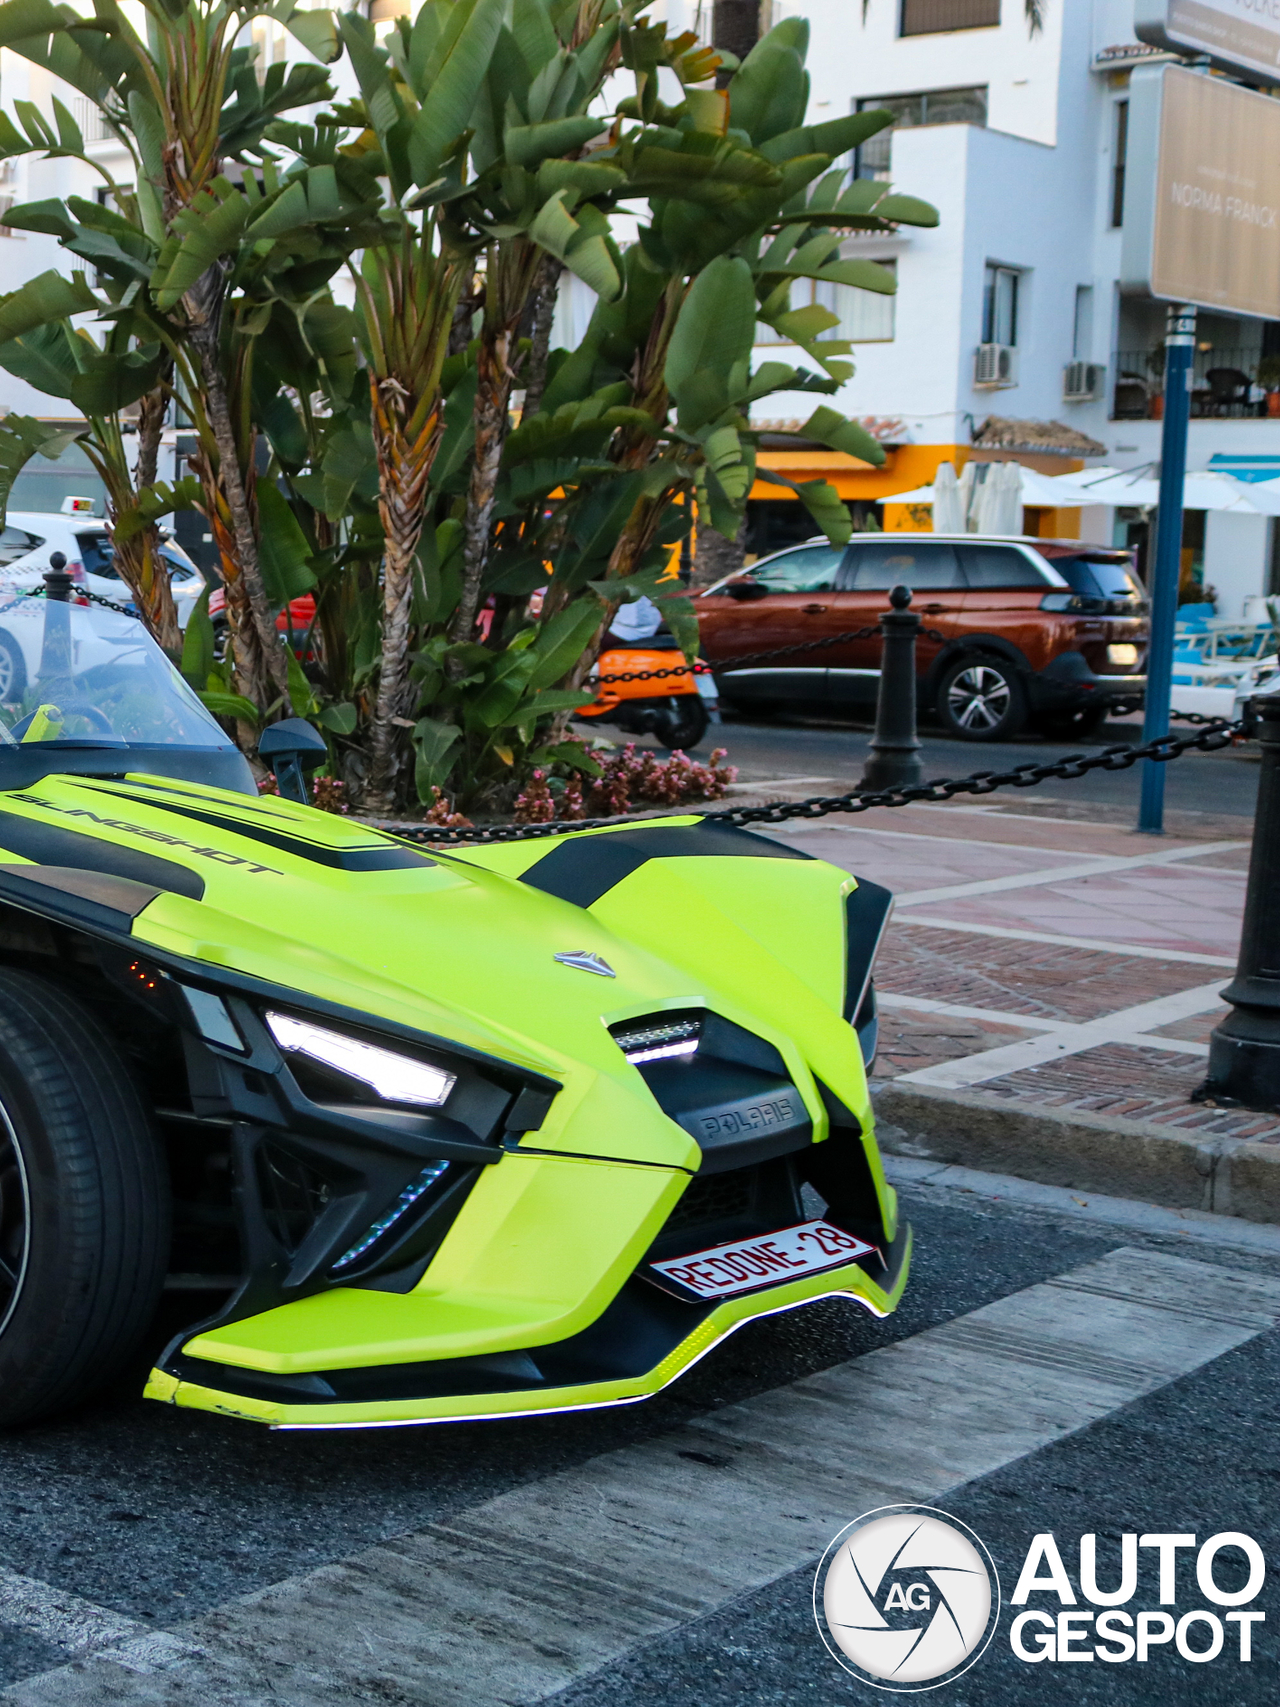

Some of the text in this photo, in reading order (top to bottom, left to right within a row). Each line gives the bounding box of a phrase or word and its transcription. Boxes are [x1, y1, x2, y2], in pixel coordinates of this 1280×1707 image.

[1171, 180, 1278, 227] NORMA FRANCK
[5, 793, 285, 876] SLINGSHOT
[700, 1097, 797, 1140] POLARIS
